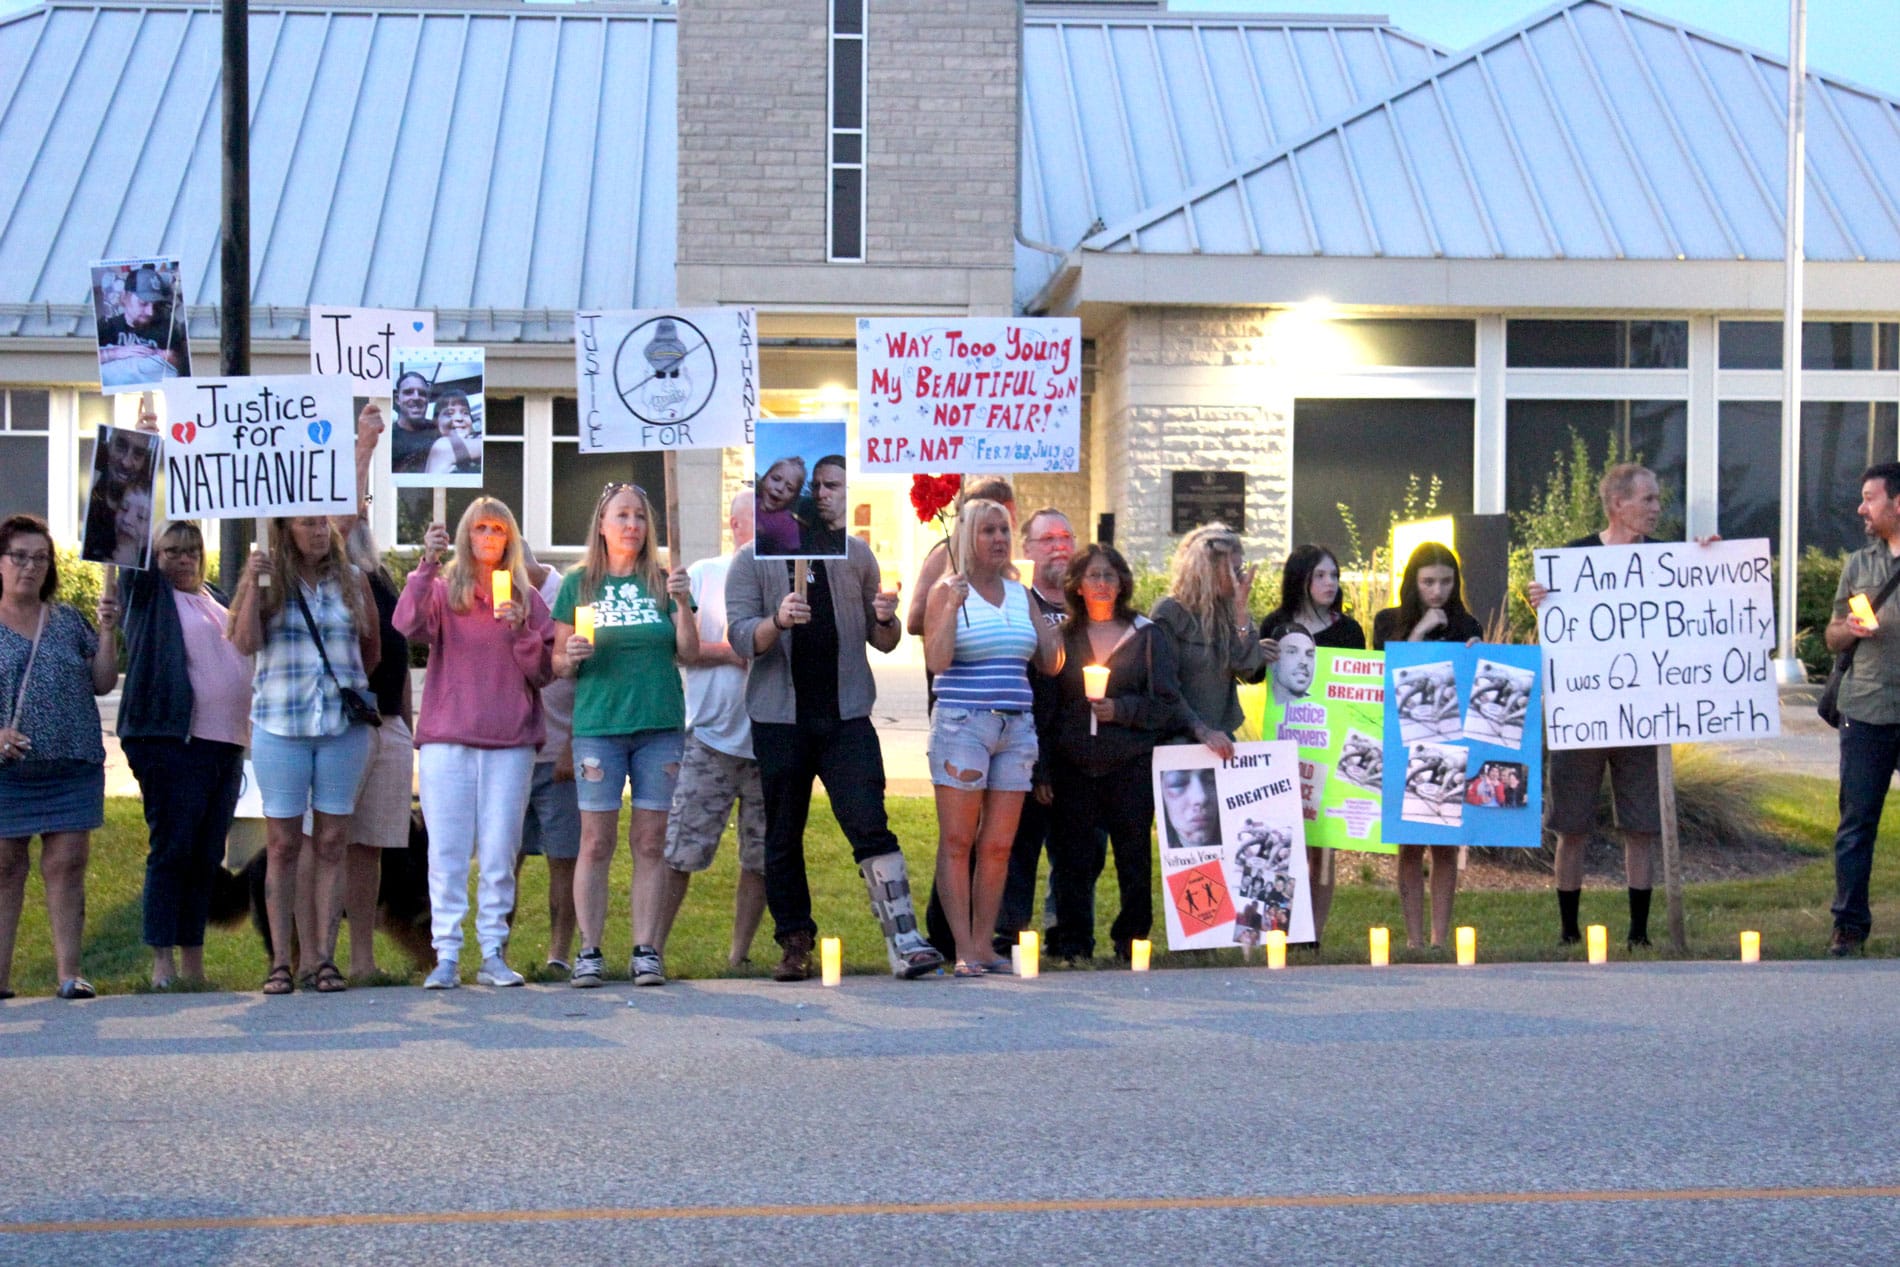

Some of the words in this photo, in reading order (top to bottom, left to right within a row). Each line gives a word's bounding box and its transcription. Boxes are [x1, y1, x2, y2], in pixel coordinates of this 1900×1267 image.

[885, 332, 933, 358] WAY
[1005, 327, 1074, 375] Young
[578, 315, 602, 448] JUSTICE
[737, 310, 756, 444] NATHANIEL
[915, 366, 1038, 398] BEAUTIFUL
[196, 384, 318, 428] Justice
[933, 403, 976, 426] NOT
[233, 425, 285, 449] for
[641, 423, 693, 447] FOR
[920, 436, 964, 461] NAT
[1540, 555, 1560, 592] I
[1574, 555, 1617, 592] Am
[1624, 552, 1644, 588] A
[1658, 552, 1770, 588] SURVIVOR
[604, 585, 616, 600] I
[593, 609, 662, 628] BEER
[1544, 606, 1579, 643] Of
[1590, 600, 1659, 641] OPP
[1665, 598, 1772, 640] Brutality
[1334, 660, 1339, 672] I
[1550, 658, 1556, 694] I
[1566, 673, 1601, 692] was
[1608, 652, 1641, 690] 62
[1652, 649, 1712, 685] Years
[1723, 647, 1767, 683] Old
[1284, 701, 1325, 726] Justice
[1549, 707, 1608, 743] from
[1619, 701, 1690, 739] North
[1697, 699, 1769, 735] Perth
[1277, 724, 1328, 747] Answers
[1231, 753, 1271, 769] CAN'T
[1225, 778, 1292, 810] BREATHE!
